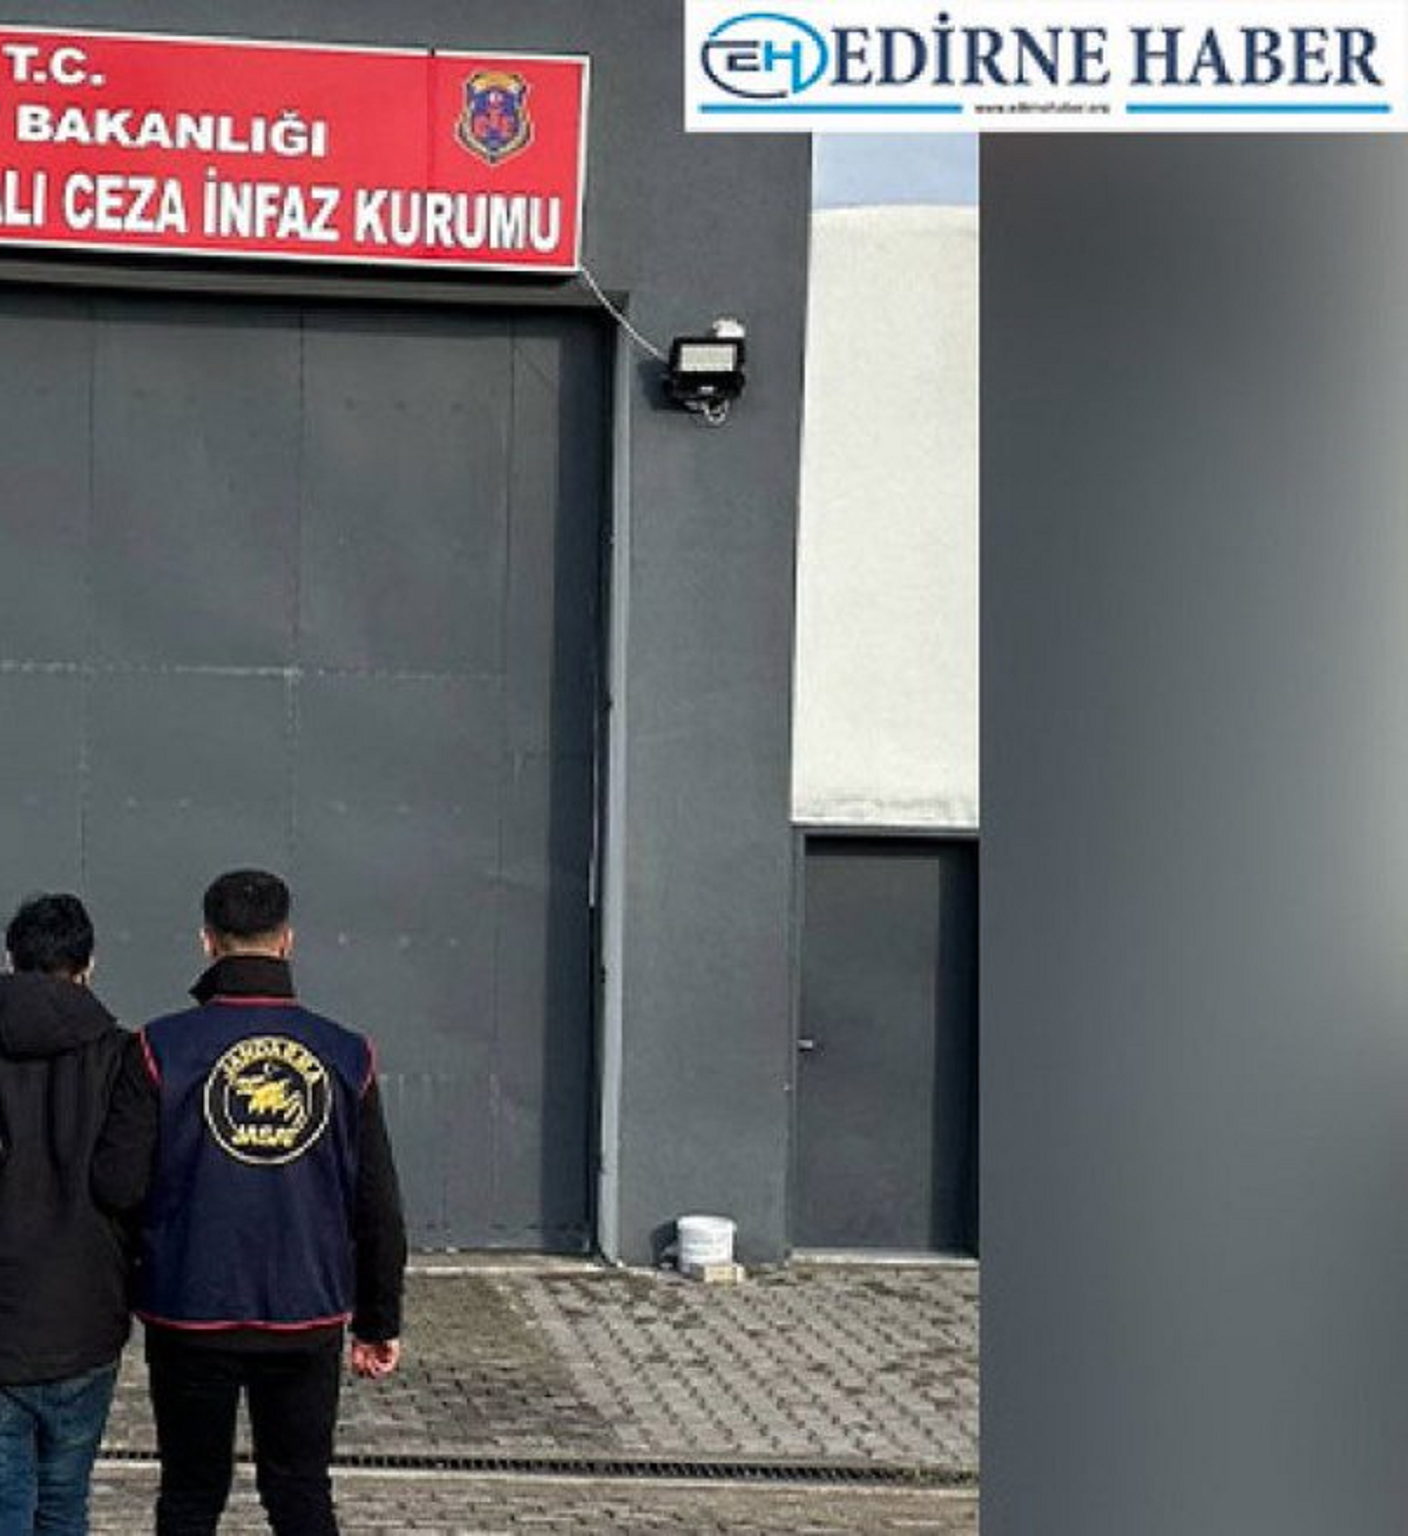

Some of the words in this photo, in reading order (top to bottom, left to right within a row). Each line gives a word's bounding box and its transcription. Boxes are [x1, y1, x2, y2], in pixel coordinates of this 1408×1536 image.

[2, 43, 105, 86] T.C.
[17, 104, 327, 157] BAKANLIĞI
[64, 173, 188, 234] CEZA
[203, 166, 340, 242] İNFAZ
[354, 188, 561, 253] KURUMU
